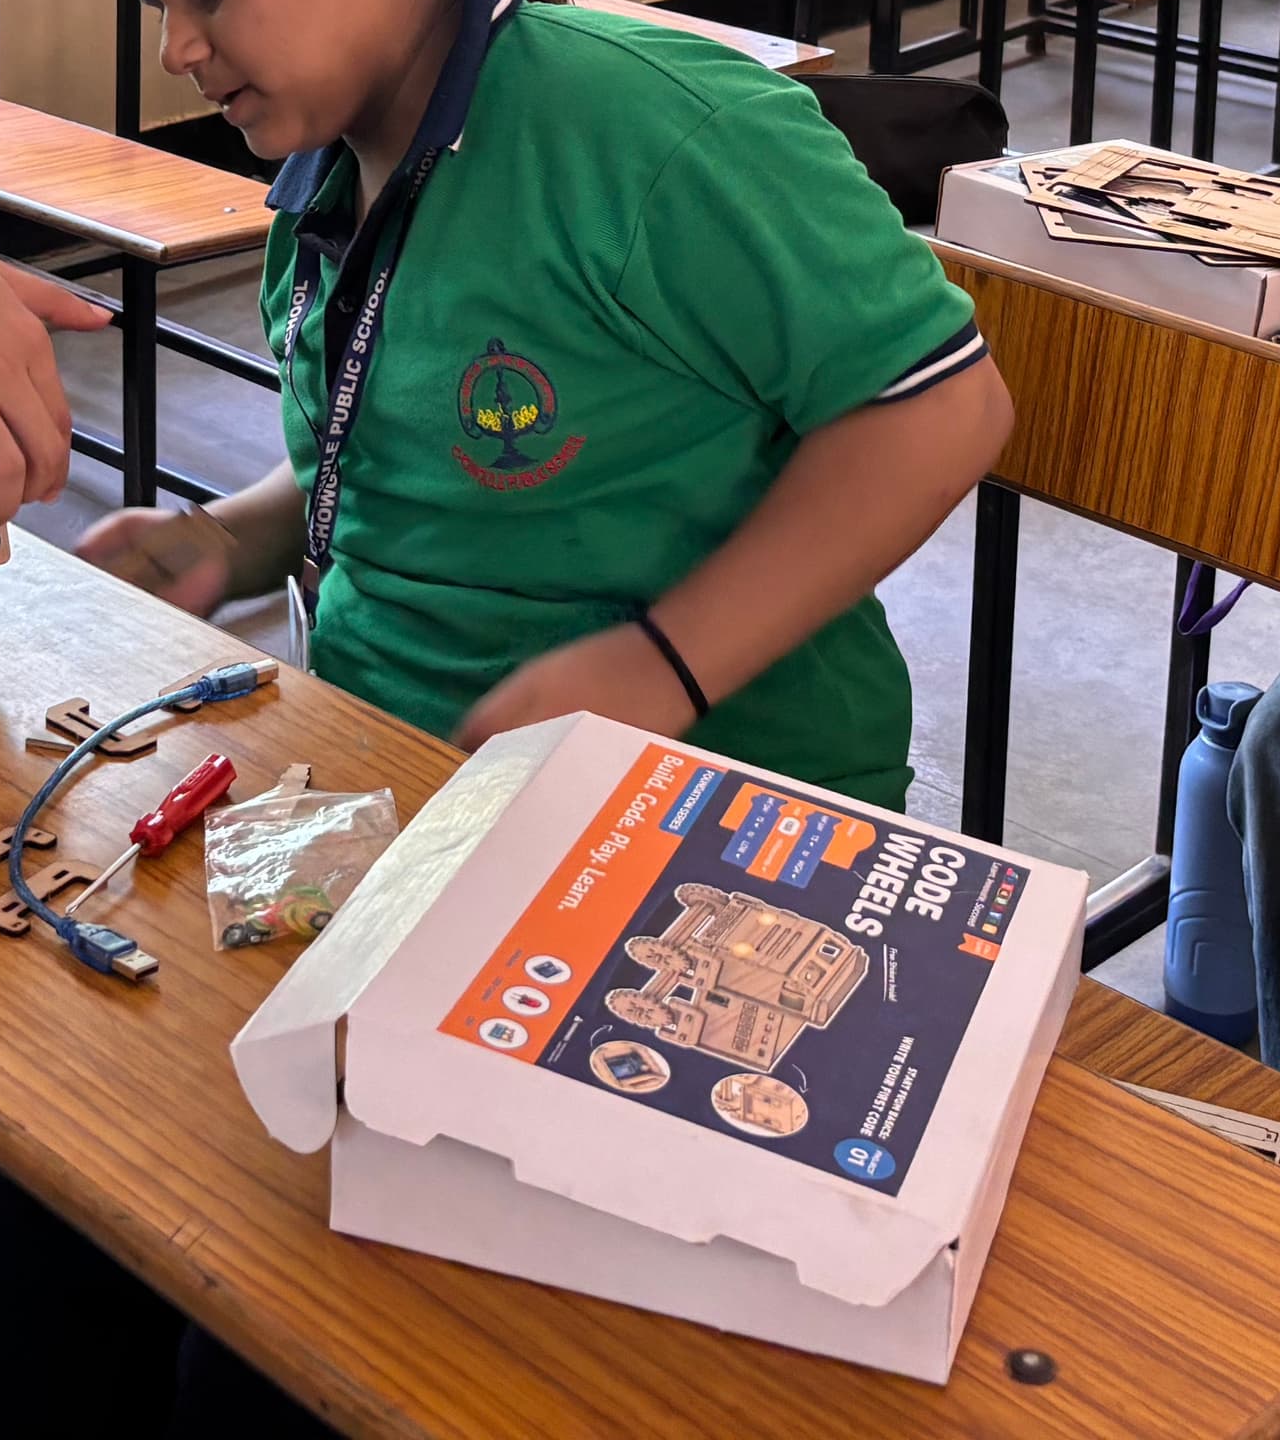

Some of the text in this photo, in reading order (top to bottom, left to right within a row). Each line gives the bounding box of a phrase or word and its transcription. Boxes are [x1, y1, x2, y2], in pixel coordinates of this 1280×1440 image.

[330, 358, 362, 435] PUBLIC
[352, 267, 390, 354] SCHOOL
[557, 753, 684, 911] Build. Code. Play. Learn.
[668, 769, 716, 831] FOUNDATION SERIES
[845, 832, 926, 937] WHEELS
[904, 846, 967, 921] CODE
[860, 1036, 915, 1137] WRITE YOUR FIRST CODE
[891, 1089, 908, 1112] FROM
[901, 1067, 918, 1091] START
[847, 1147, 869, 1167] 01
